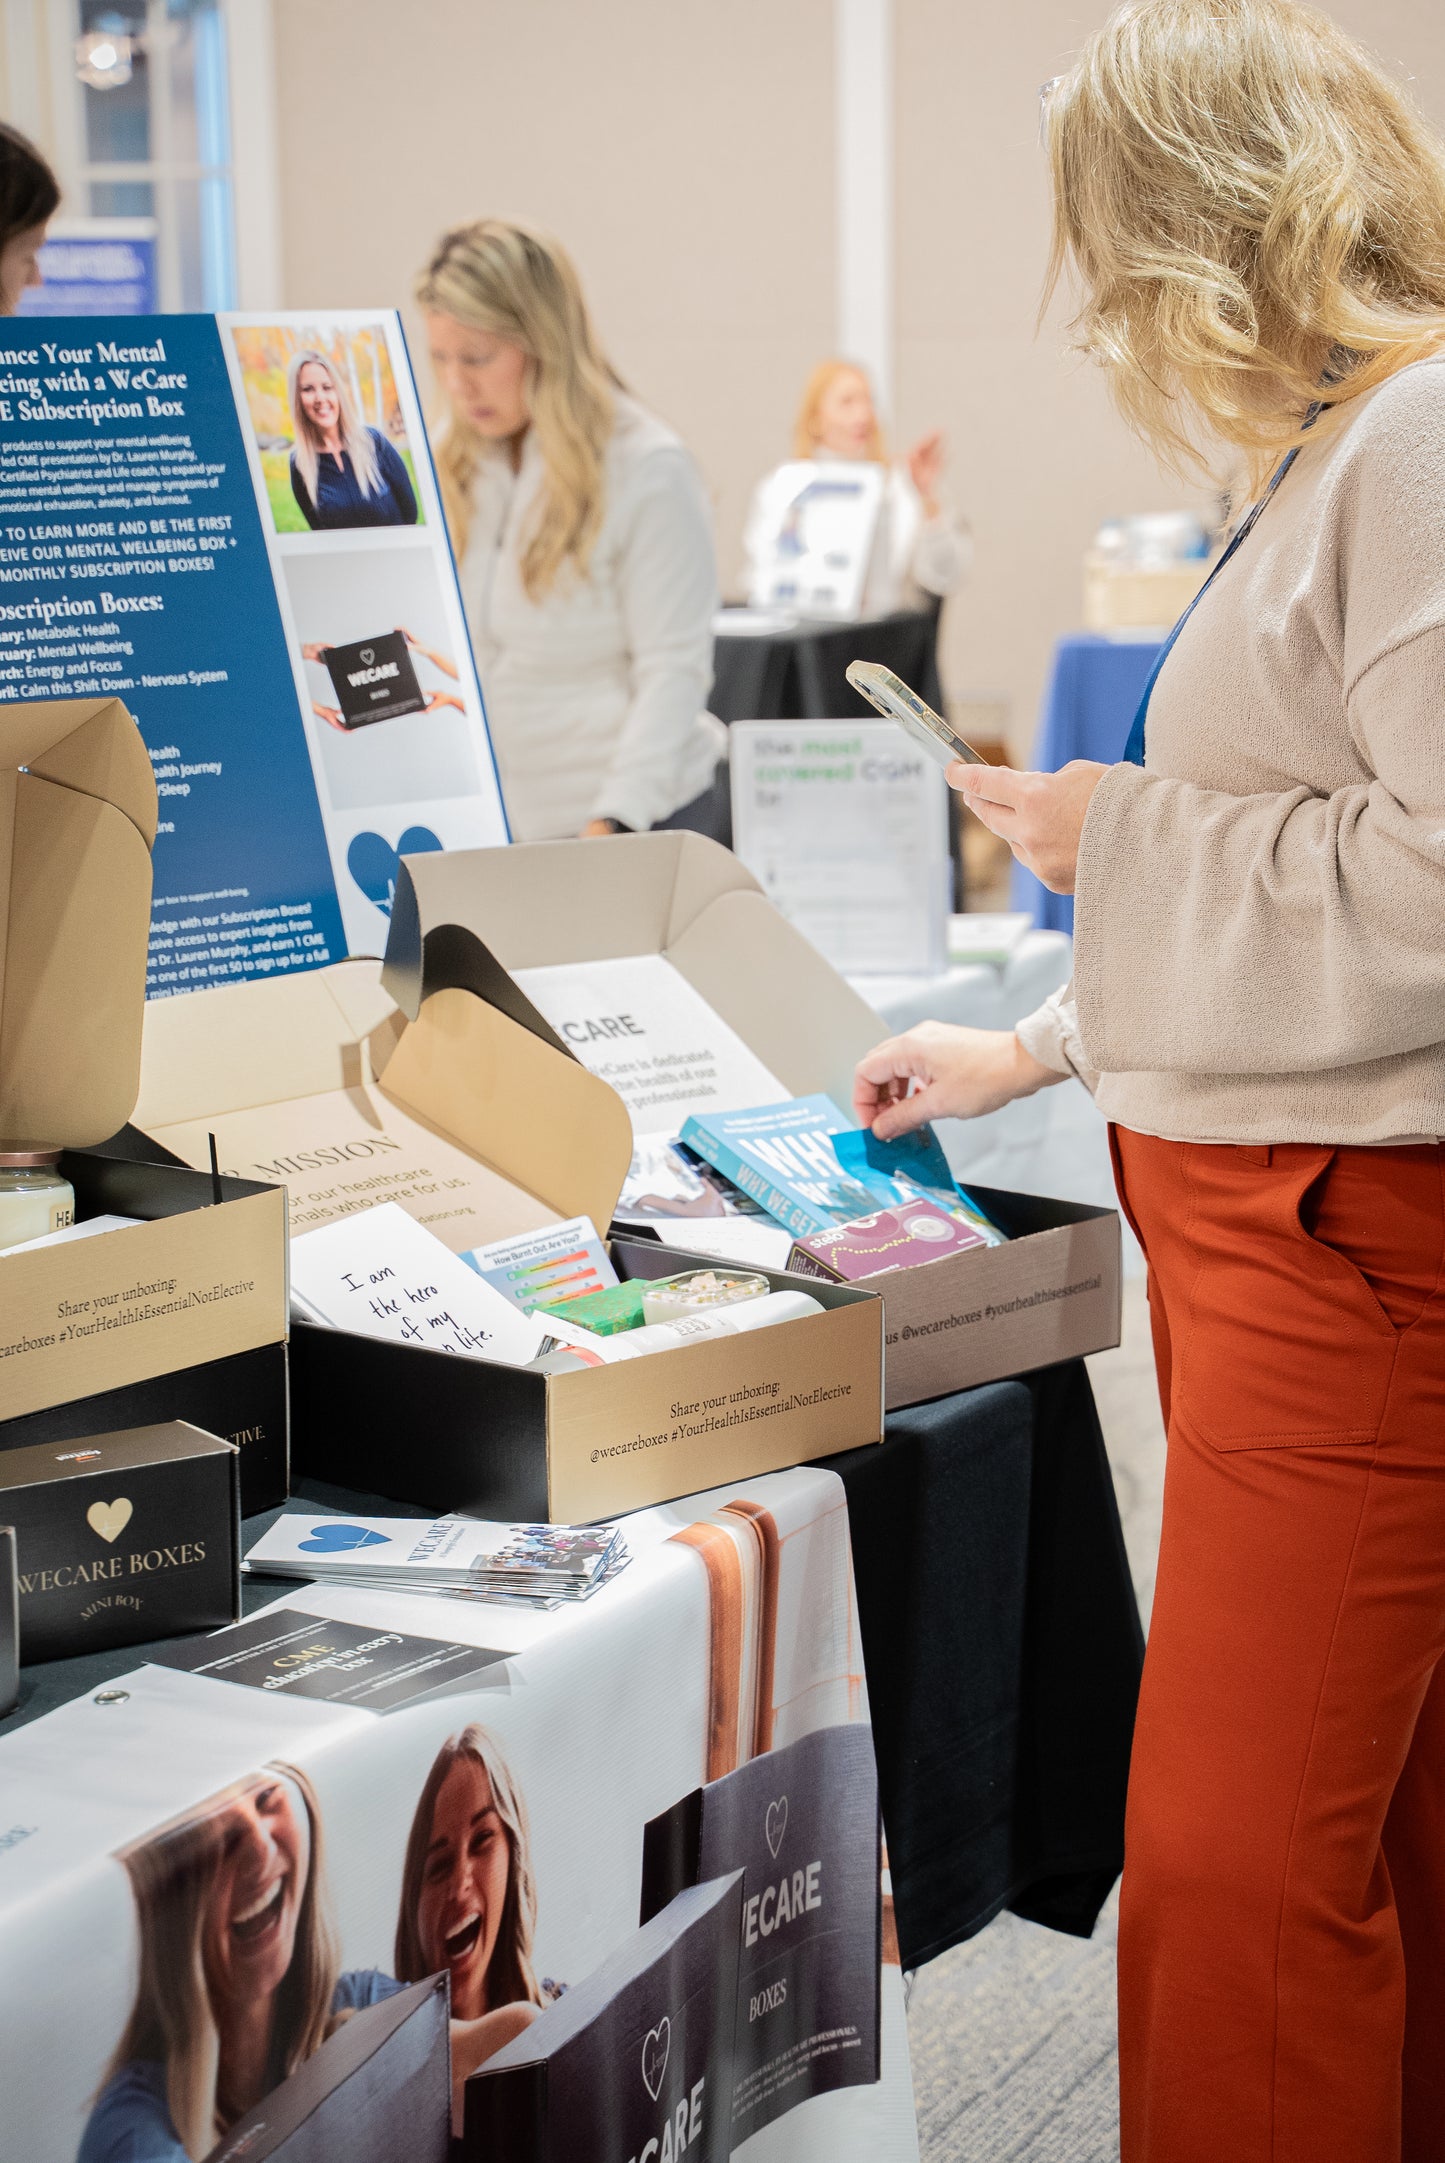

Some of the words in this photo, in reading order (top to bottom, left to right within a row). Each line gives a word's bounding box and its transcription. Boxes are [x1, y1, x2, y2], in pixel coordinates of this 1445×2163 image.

[41, 343, 93, 364] Your
[95, 338, 167, 363] Mental
[43, 368, 90, 391] with
[94, 376, 106, 390] a
[108, 368, 188, 390] WeCare
[18, 397, 143, 426] Subscription
[146, 396, 185, 417] Box
[44, 440, 56, 450] to
[56, 438, 93, 451] support
[93, 437, 114, 450] your
[116, 434, 148, 448] mental
[148, 434, 192, 448] wellbeing
[0, 469, 40, 482] Certified
[40, 468, 93, 482] Psychiatrist
[94, 466, 112, 478] and
[112, 466, 129, 477] Life
[160, 465, 171, 476] to
[171, 462, 205, 477] expand
[205, 463, 226, 476] your
[17, 455, 39, 466] CME
[40, 453, 98, 468] presentation
[98, 451, 111, 465] by
[111, 451, 127, 462] Dr.
[127, 450, 159, 462] Lauren
[159, 449, 197, 462] Murphy,
[28, 484, 61, 496] mental
[61, 482, 106, 496] wellbeing
[106, 481, 125, 493] and
[125, 481, 161, 494] manage
[161, 479, 209, 493] symptoms
[208, 476, 219, 488] of
[43, 499, 97, 512] exhaustion,
[97, 497, 133, 510] anxiety,
[134, 495, 152, 507] and
[5, 526, 26, 541] TO
[29, 524, 73, 540] LEARN
[75, 522, 116, 538] MORE
[118, 520, 148, 535] AND
[150, 519, 168, 534] BE
[169, 517, 196, 532] THE
[197, 515, 232, 531] FIRST
[32, 545, 63, 560] OUR
[65, 542, 120, 558] MENTAL
[121, 537, 197, 556] WELLBEING
[199, 536, 228, 551] BOX
[0, 565, 66, 582] MONTHLY
[70, 559, 166, 579] SUBSCRIPTION
[168, 555, 215, 573] BOXES!
[100, 591, 164, 614] Boxes:
[26, 625, 82, 641] Metabolic
[82, 621, 120, 636] Health
[37, 643, 77, 658] Mental
[77, 640, 134, 655] Wellbeing
[20, 683, 50, 697] Calm
[51, 680, 73, 695] this
[73, 678, 100, 693] Shift
[101, 677, 134, 691] Down
[141, 673, 188, 687] Nervous
[188, 669, 228, 687] System
[25, 664, 64, 679] Energy
[66, 660, 88, 675] and
[89, 660, 123, 673] Focus
[180, 761, 222, 778] Journey
[179, 915, 201, 929] with
[202, 915, 219, 927] our
[220, 907, 280, 925] Subscription
[174, 933, 207, 947] access
[207, 932, 218, 943] to
[219, 927, 251, 943] expert
[251, 922, 289, 938] insights
[288, 919, 313, 932] from
[158, 953, 175, 966] Dr.
[175, 950, 210, 964] Lauren
[210, 943, 251, 959] Murphy,
[252, 940, 271, 953] and
[271, 938, 294, 951] earn
[302, 932, 325, 947] CME
[158, 970, 178, 982] one
[178, 966, 190, 980] of
[190, 965, 208, 979] the
[208, 962, 229, 976] first
[242, 960, 255, 972] to
[255, 957, 275, 971] sign
[275, 955, 290, 969] up
[289, 952, 305, 965] for
[313, 947, 330, 962] full
[560, 1015, 646, 1043] CARE
[252, 1136, 402, 1179] MISSION
[308, 1187, 341, 1202] our
[338, 1168, 432, 1195] healthcare
[333, 1198, 374, 1214] who
[375, 1189, 415, 1204] care
[412, 1183, 440, 1195] for
[442, 1178, 472, 1189] us.
[735, 1163, 770, 1198] WHY
[766, 1188, 793, 1218] WE
[788, 1208, 819, 1237] GET
[493, 1255, 511, 1266] How
[511, 1248, 532, 1260] Burnt
[532, 1244, 548, 1254] Out
[548, 1241, 562, 1249] Are
[563, 1233, 580, 1245] You?
[810, 1231, 846, 1249] stelo
[341, 1273, 364, 1292] I
[369, 1267, 396, 1284] am
[57, 1299, 90, 1319] Share
[94, 1289, 120, 1317] your
[122, 1278, 177, 1301] unboxing:
[59, 1279, 255, 1343] #YourHealthIsEssentialNotElective
[368, 1297, 402, 1318] the
[403, 1287, 438, 1303] hero
[885, 1331, 899, 1345] us
[901, 1310, 982, 1341] @wecareboxes
[984, 1274, 1102, 1319] #yourhealthisessential
[400, 1316, 424, 1341] of
[426, 1311, 460, 1330] my
[670, 1401, 700, 1419] Share
[702, 1393, 727, 1416] your
[729, 1380, 780, 1404] unboxing:
[590, 1430, 668, 1463] @wecareboxes
[671, 1383, 852, 1442] #YourHealthIsEssentialNotElective
[407, 1523, 454, 1561] WECARE
[18, 1557, 123, 1595] WECARE
[130, 1541, 207, 1574] BOXES
[80, 1596, 114, 1621] MINI
[115, 1594, 143, 1612] BOX
[262, 1654, 342, 1690] education
[336, 1649, 361, 1662] in
[356, 1632, 403, 1653] every
[272, 1644, 335, 1668] CME
[330, 1655, 373, 1672] box
[742, 1861, 822, 1948] ECARE
[749, 1978, 787, 2023] BOXES
